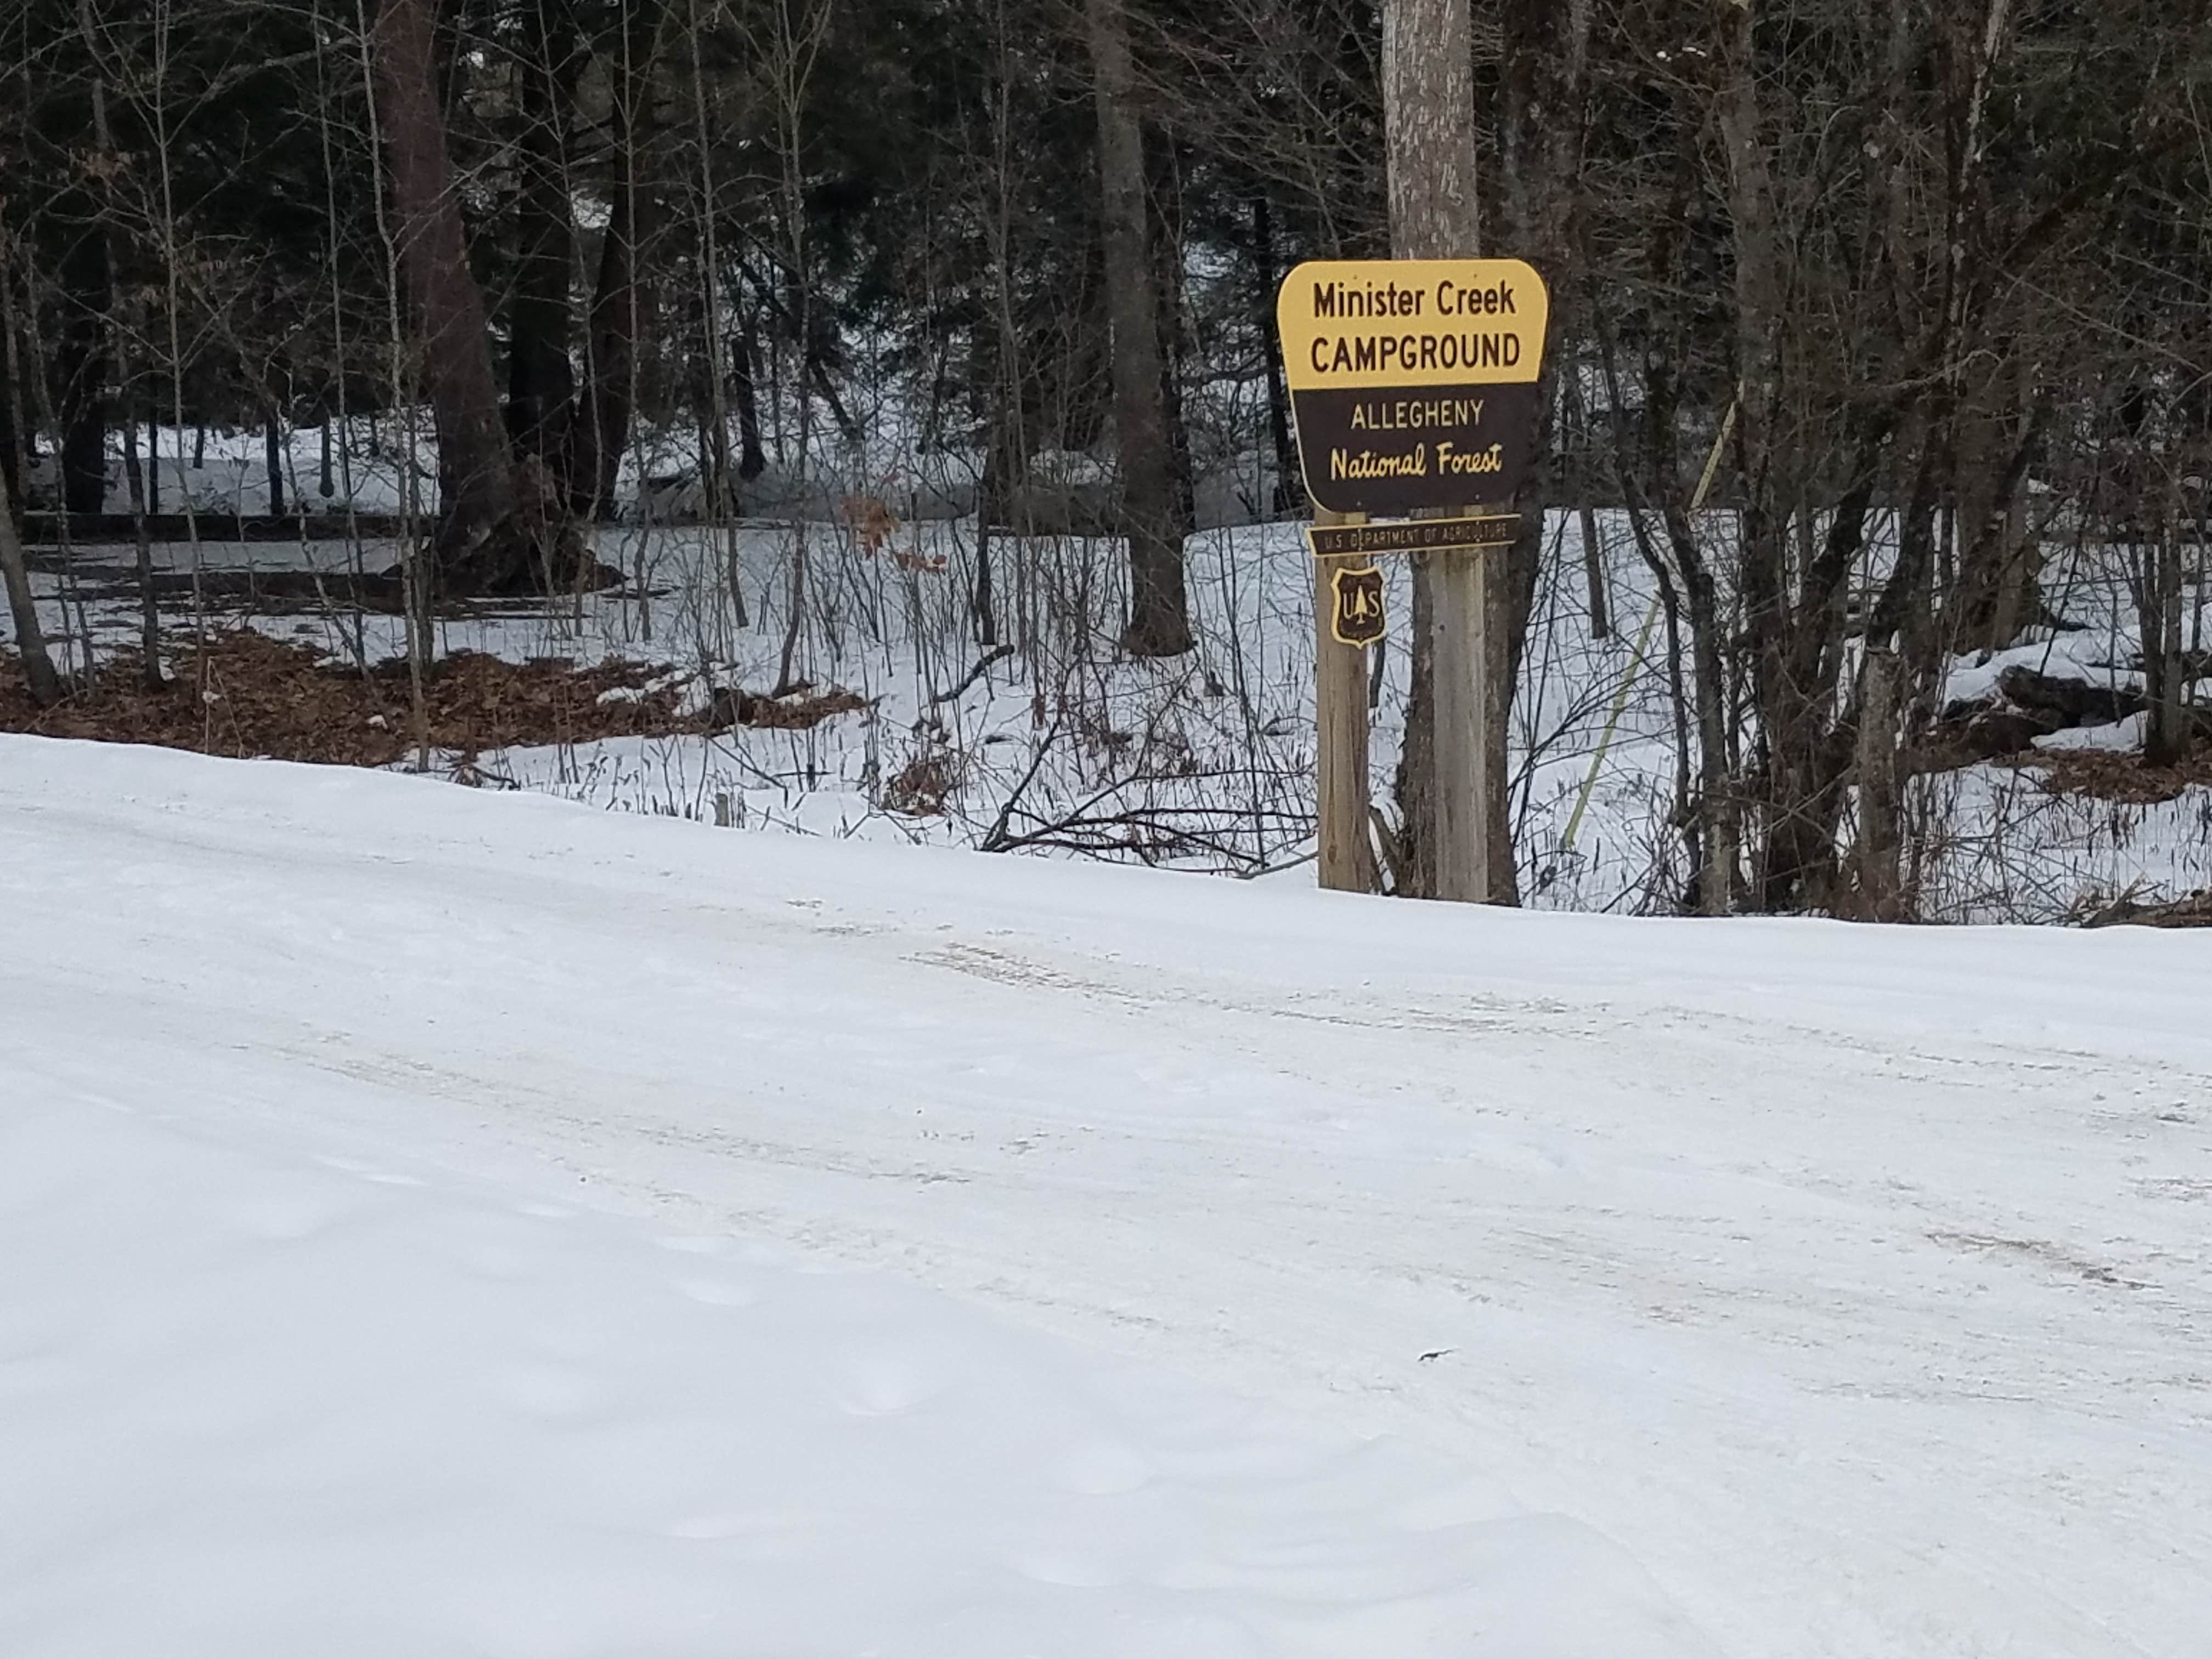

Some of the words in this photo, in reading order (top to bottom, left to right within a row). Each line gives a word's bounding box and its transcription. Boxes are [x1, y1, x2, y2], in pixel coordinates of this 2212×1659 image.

[1313, 281, 1424, 318] Minister
[1437, 279, 1516, 315] Creek
[1311, 332, 1520, 373] CAMPGROUND
[1351, 399, 1485, 430] ALLEGHENY
[1330, 443, 1427, 482] National
[1436, 441, 1503, 475] Forest
[1350, 528, 1419, 548] DEPARTMENT
[1424, 527, 1437, 543] OF
